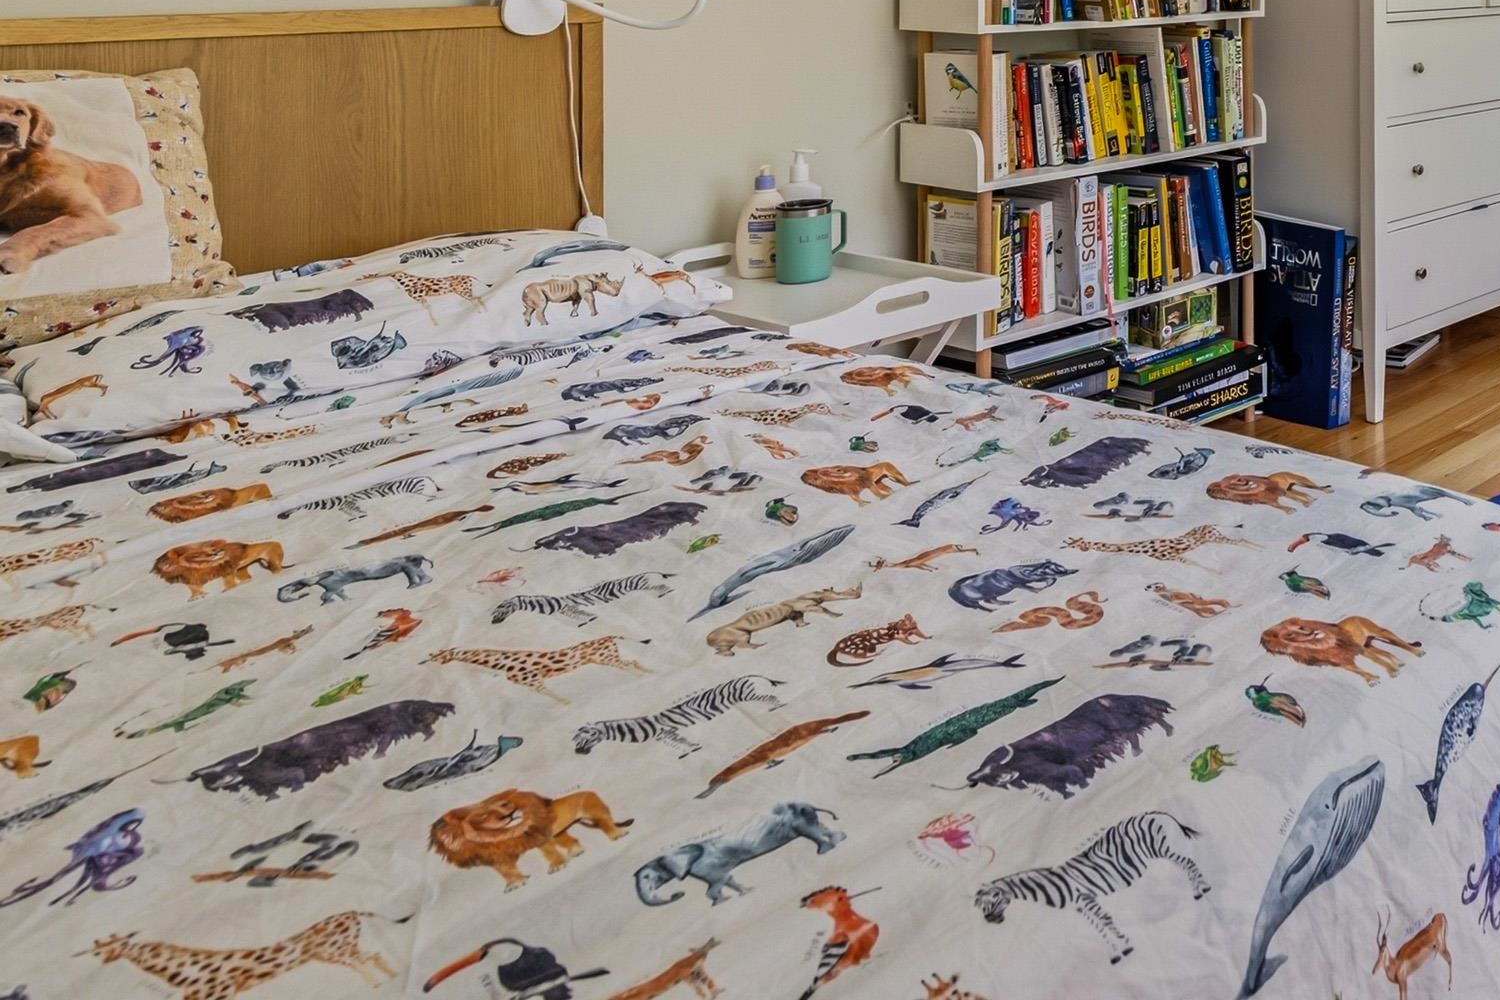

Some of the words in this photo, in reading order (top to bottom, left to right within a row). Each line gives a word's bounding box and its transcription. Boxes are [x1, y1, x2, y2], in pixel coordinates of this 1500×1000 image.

[1081, 201, 1096, 262] BIRDS
[1239, 196, 1253, 262] BIRDS
[999, 243, 1010, 300] BIRDS
[1332, 298, 1341, 336] WORLD
[1210, 383, 1249, 407] SHARKS
